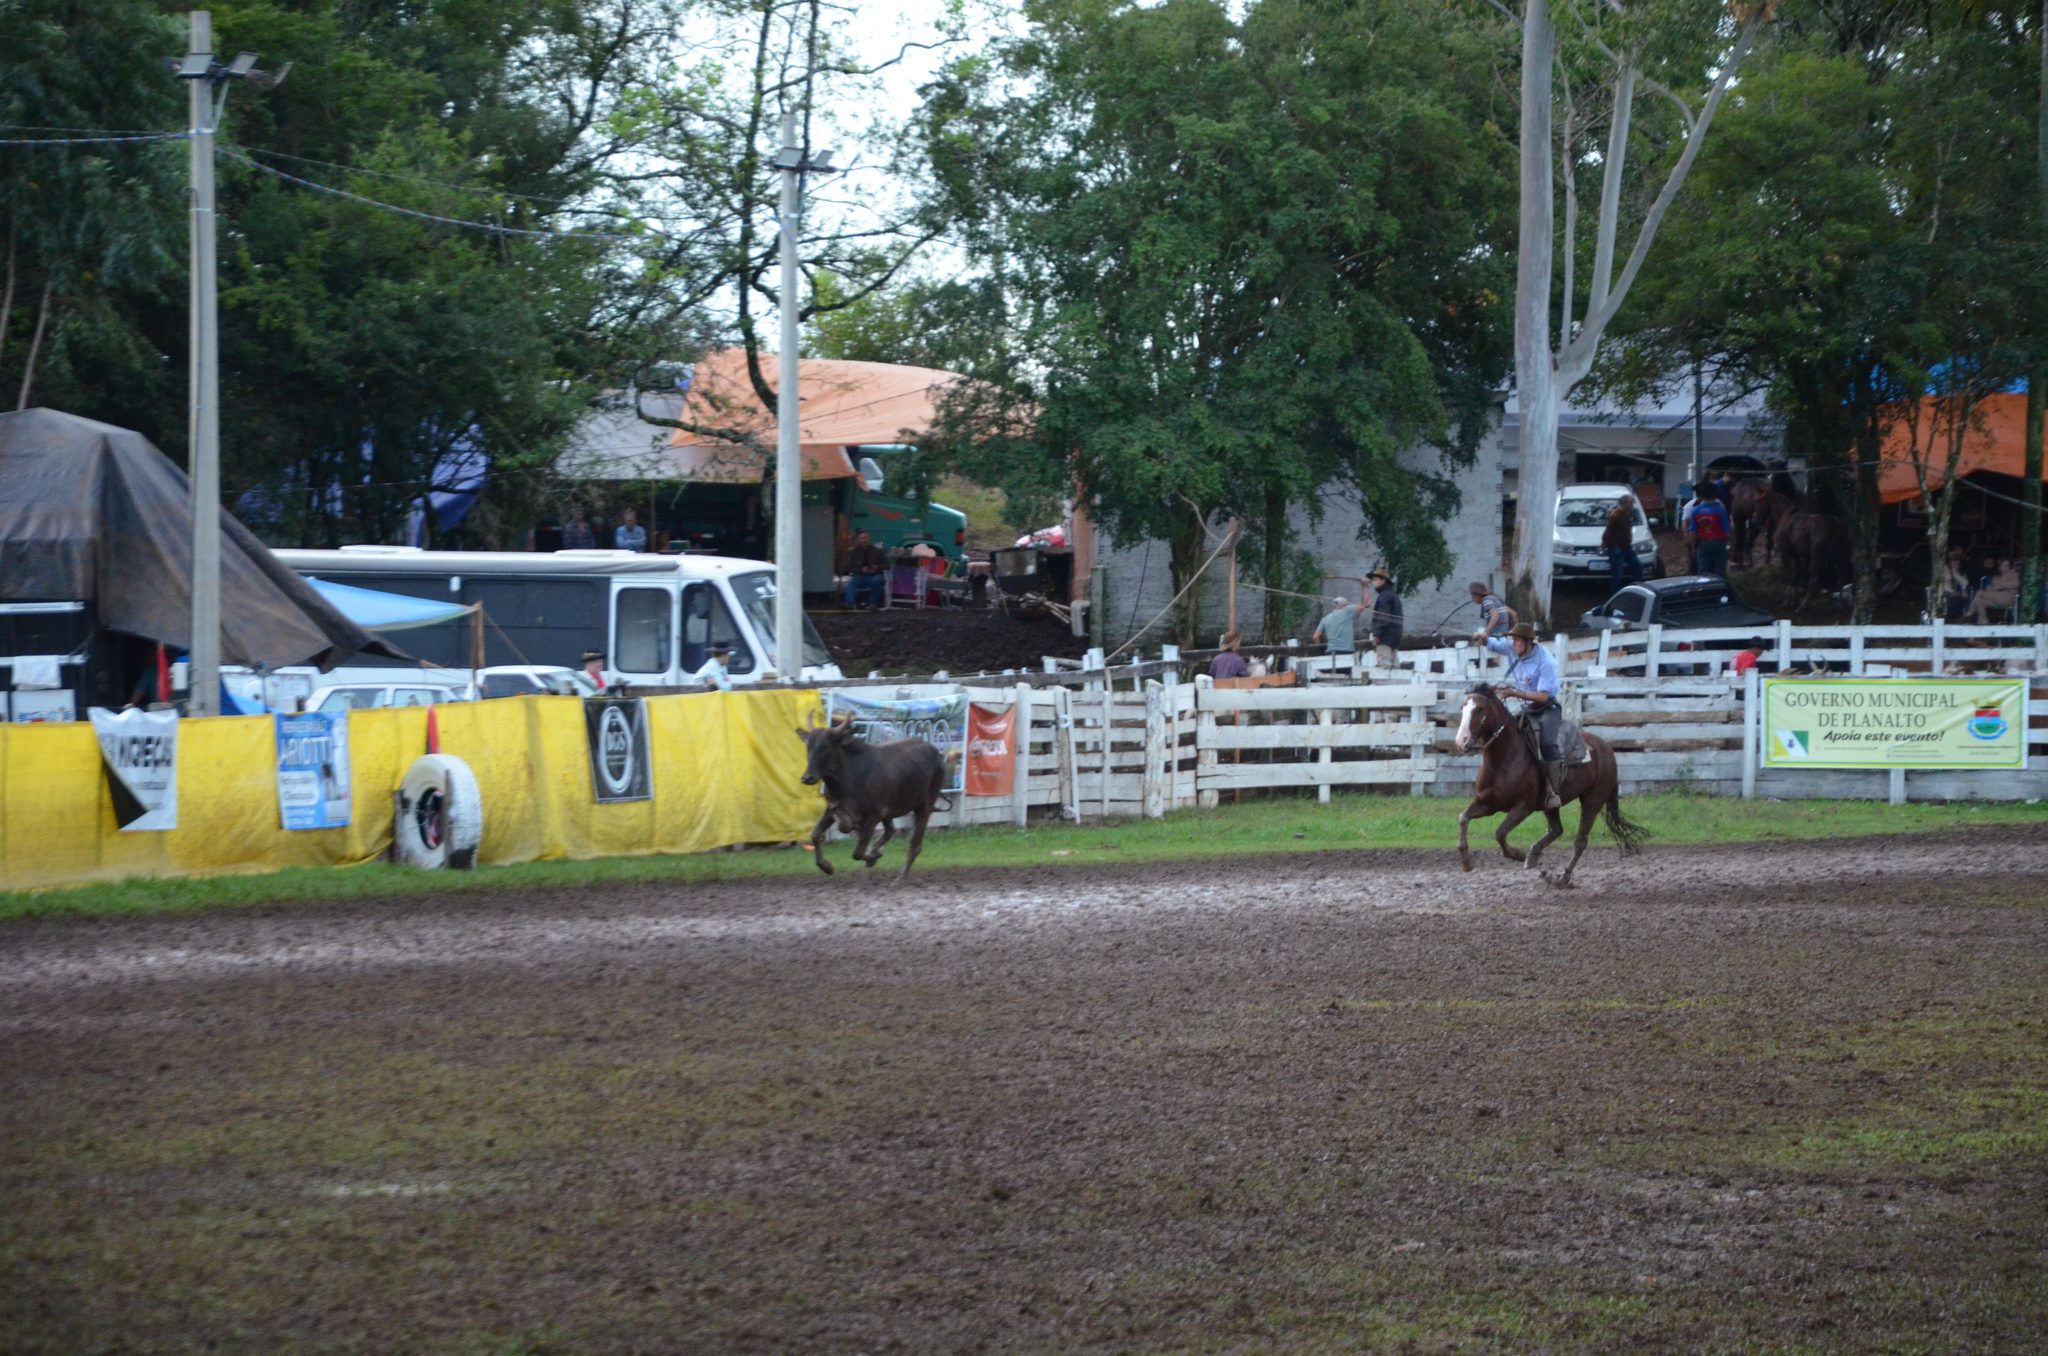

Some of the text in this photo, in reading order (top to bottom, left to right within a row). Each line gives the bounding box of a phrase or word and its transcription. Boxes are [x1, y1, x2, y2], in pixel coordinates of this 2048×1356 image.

[1784, 692, 1959, 708] GOVERNO MUNICIPAL
[1818, 713, 1926, 727] DE PLANALTO
[1823, 730, 1945, 743] Apoia este evento!
